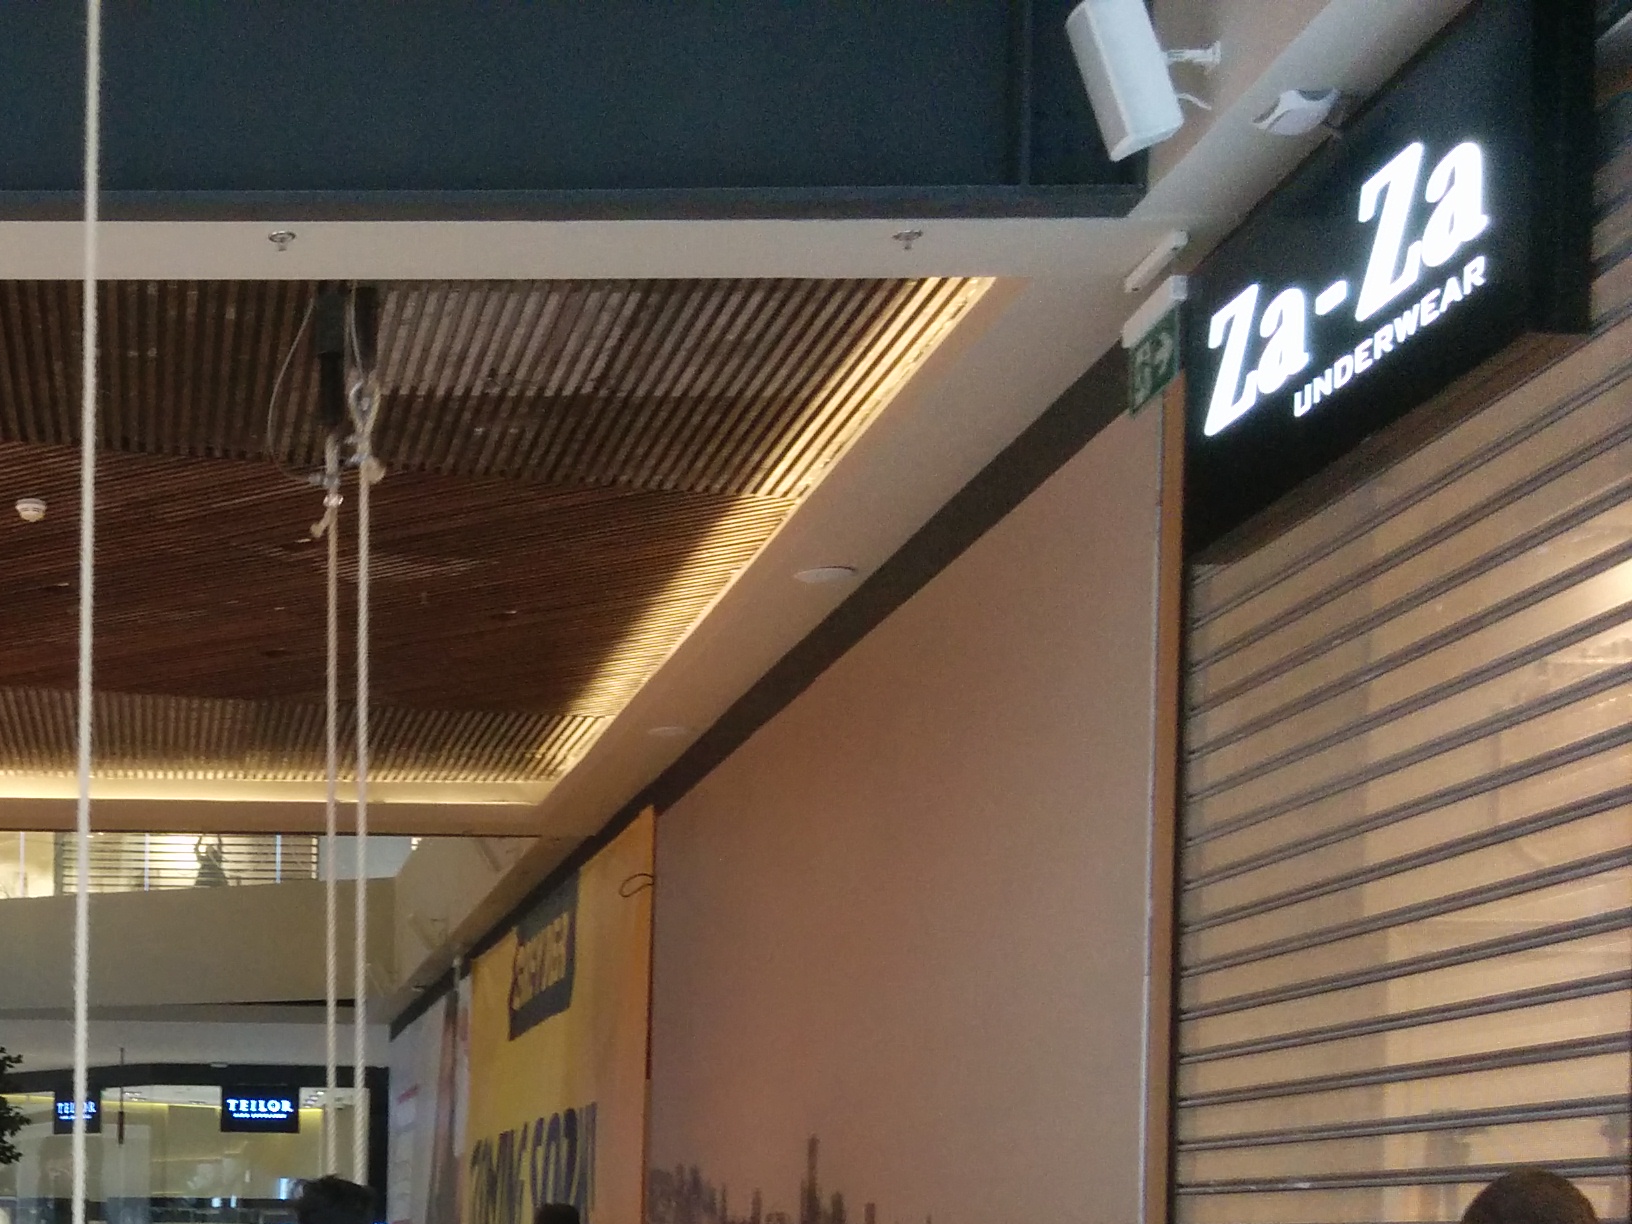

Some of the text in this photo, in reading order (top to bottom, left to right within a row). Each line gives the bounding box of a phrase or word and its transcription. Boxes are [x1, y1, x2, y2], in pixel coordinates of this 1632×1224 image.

[1202, 141, 1491, 437] Za-Za
[1293, 255, 1487, 418] UNDERWEAR
[56, 1101, 97, 1114] TEIOR
[226, 1098, 294, 1112] TEILOR
